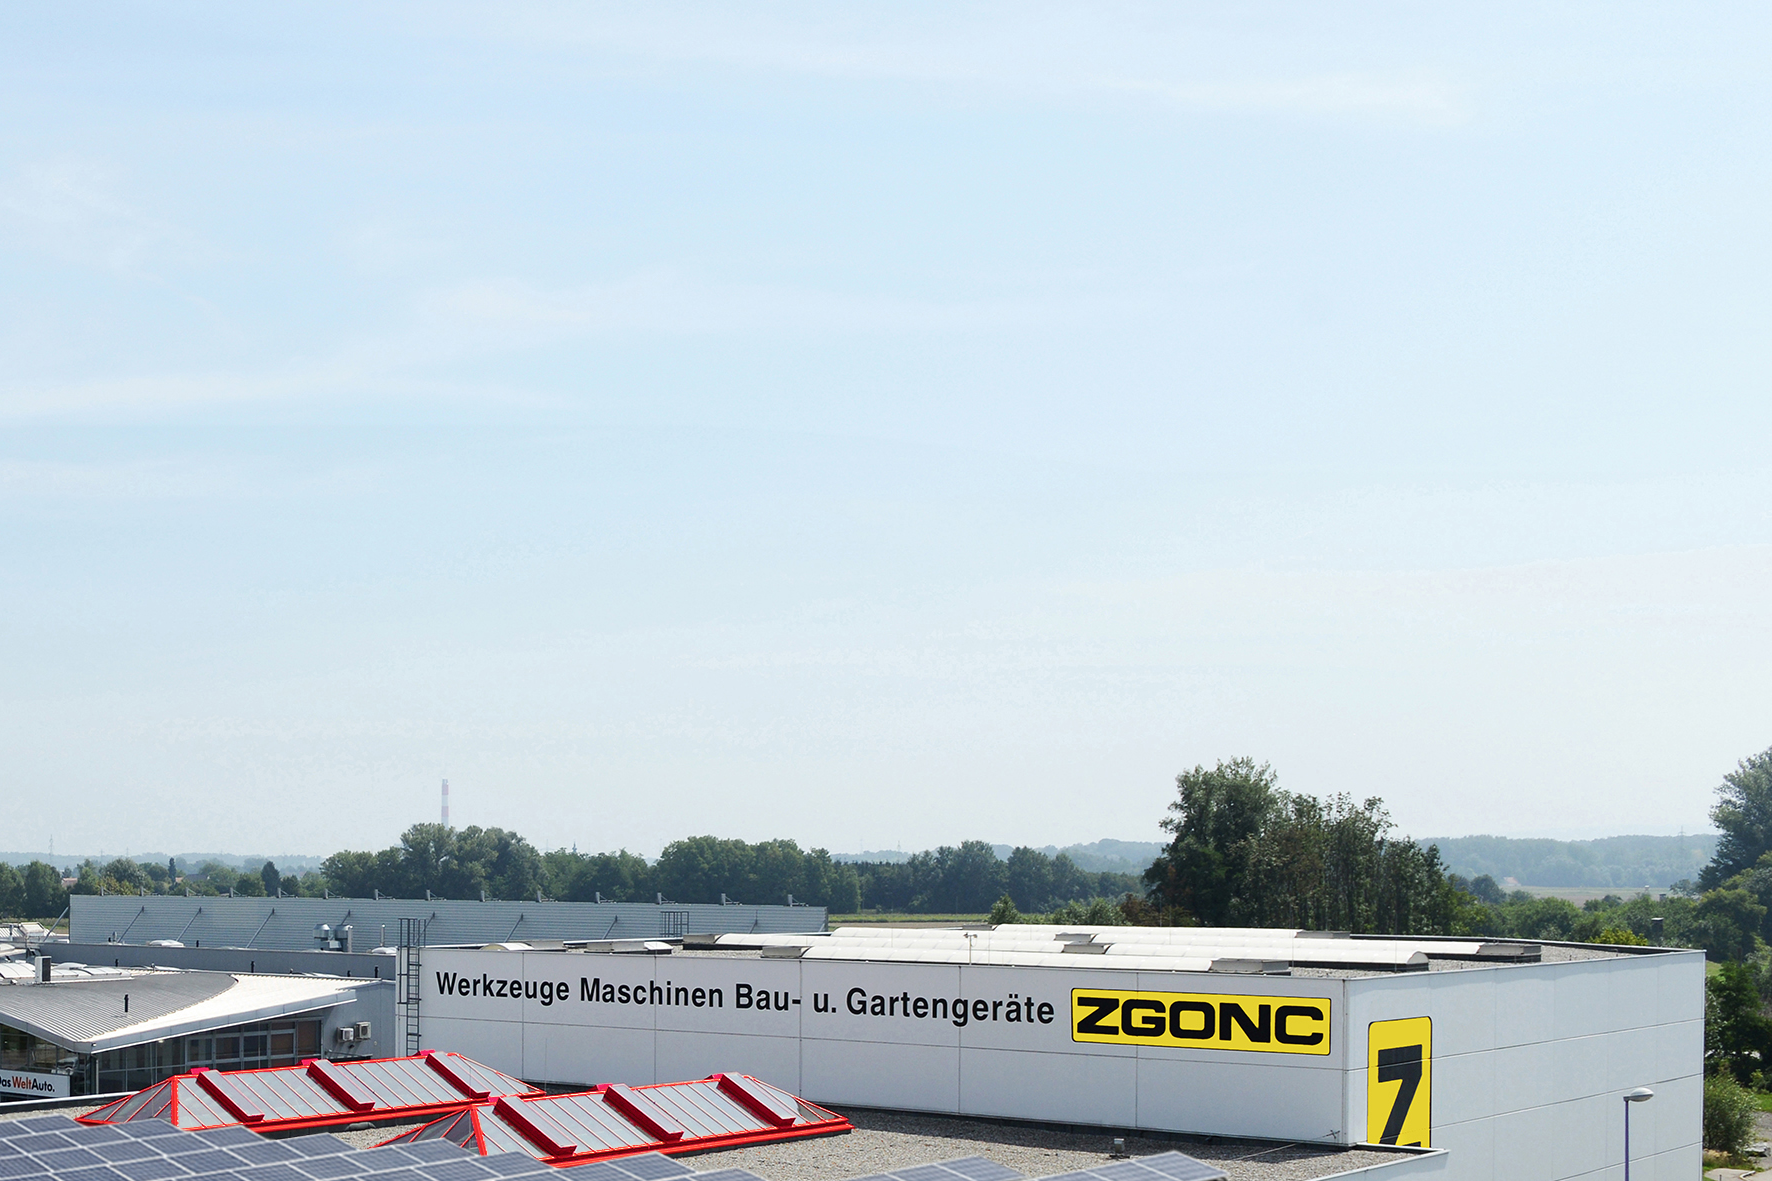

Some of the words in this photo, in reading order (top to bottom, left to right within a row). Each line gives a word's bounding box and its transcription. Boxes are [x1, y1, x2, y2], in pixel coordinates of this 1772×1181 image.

[435, 971, 570, 1007] Werkzeuge
[580, 977, 724, 1009] Maschinen
[735, 983, 801, 1011] Bau-
[812, 991, 837, 1013] u.
[846, 987, 1055, 1027] Gartengeräte
[1076, 996, 1324, 1046] ZGONC
